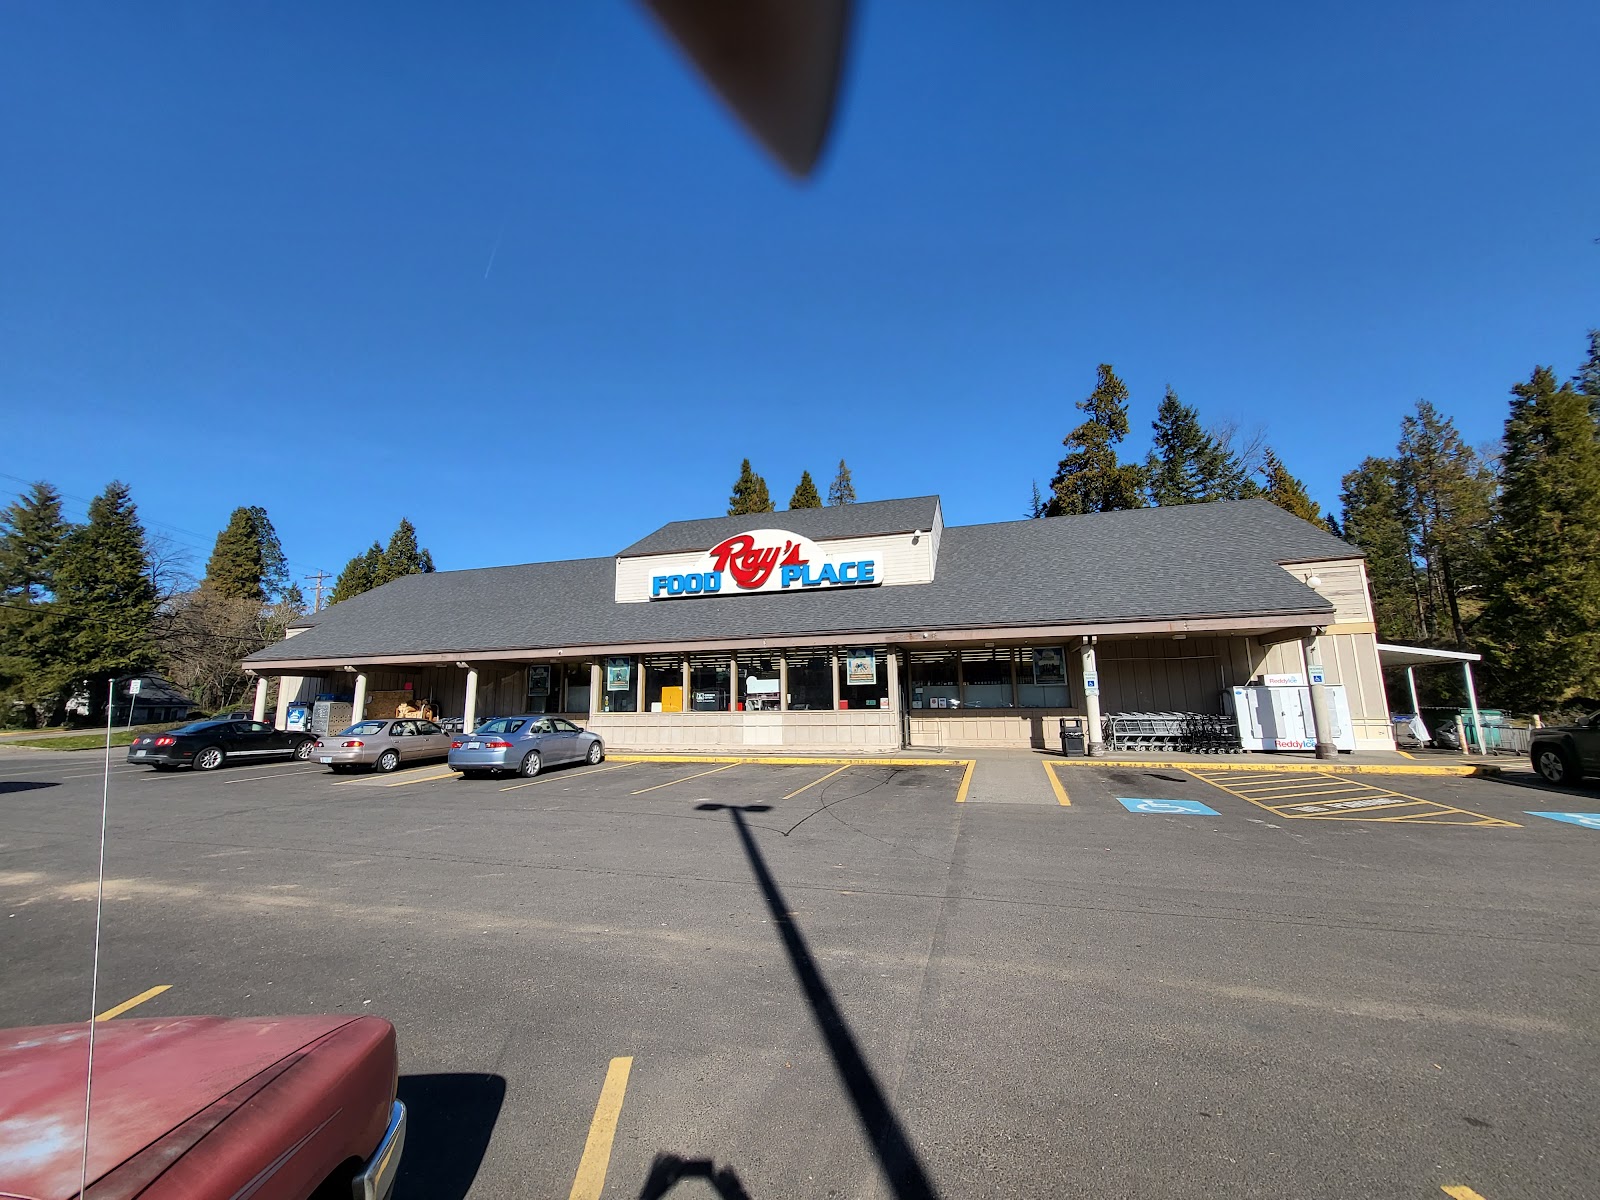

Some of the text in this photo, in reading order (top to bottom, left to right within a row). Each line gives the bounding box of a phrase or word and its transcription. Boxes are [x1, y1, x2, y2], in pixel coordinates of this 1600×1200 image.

[652, 560, 875, 596] FOOD PLACE
[709, 534, 809, 590] Ray's
